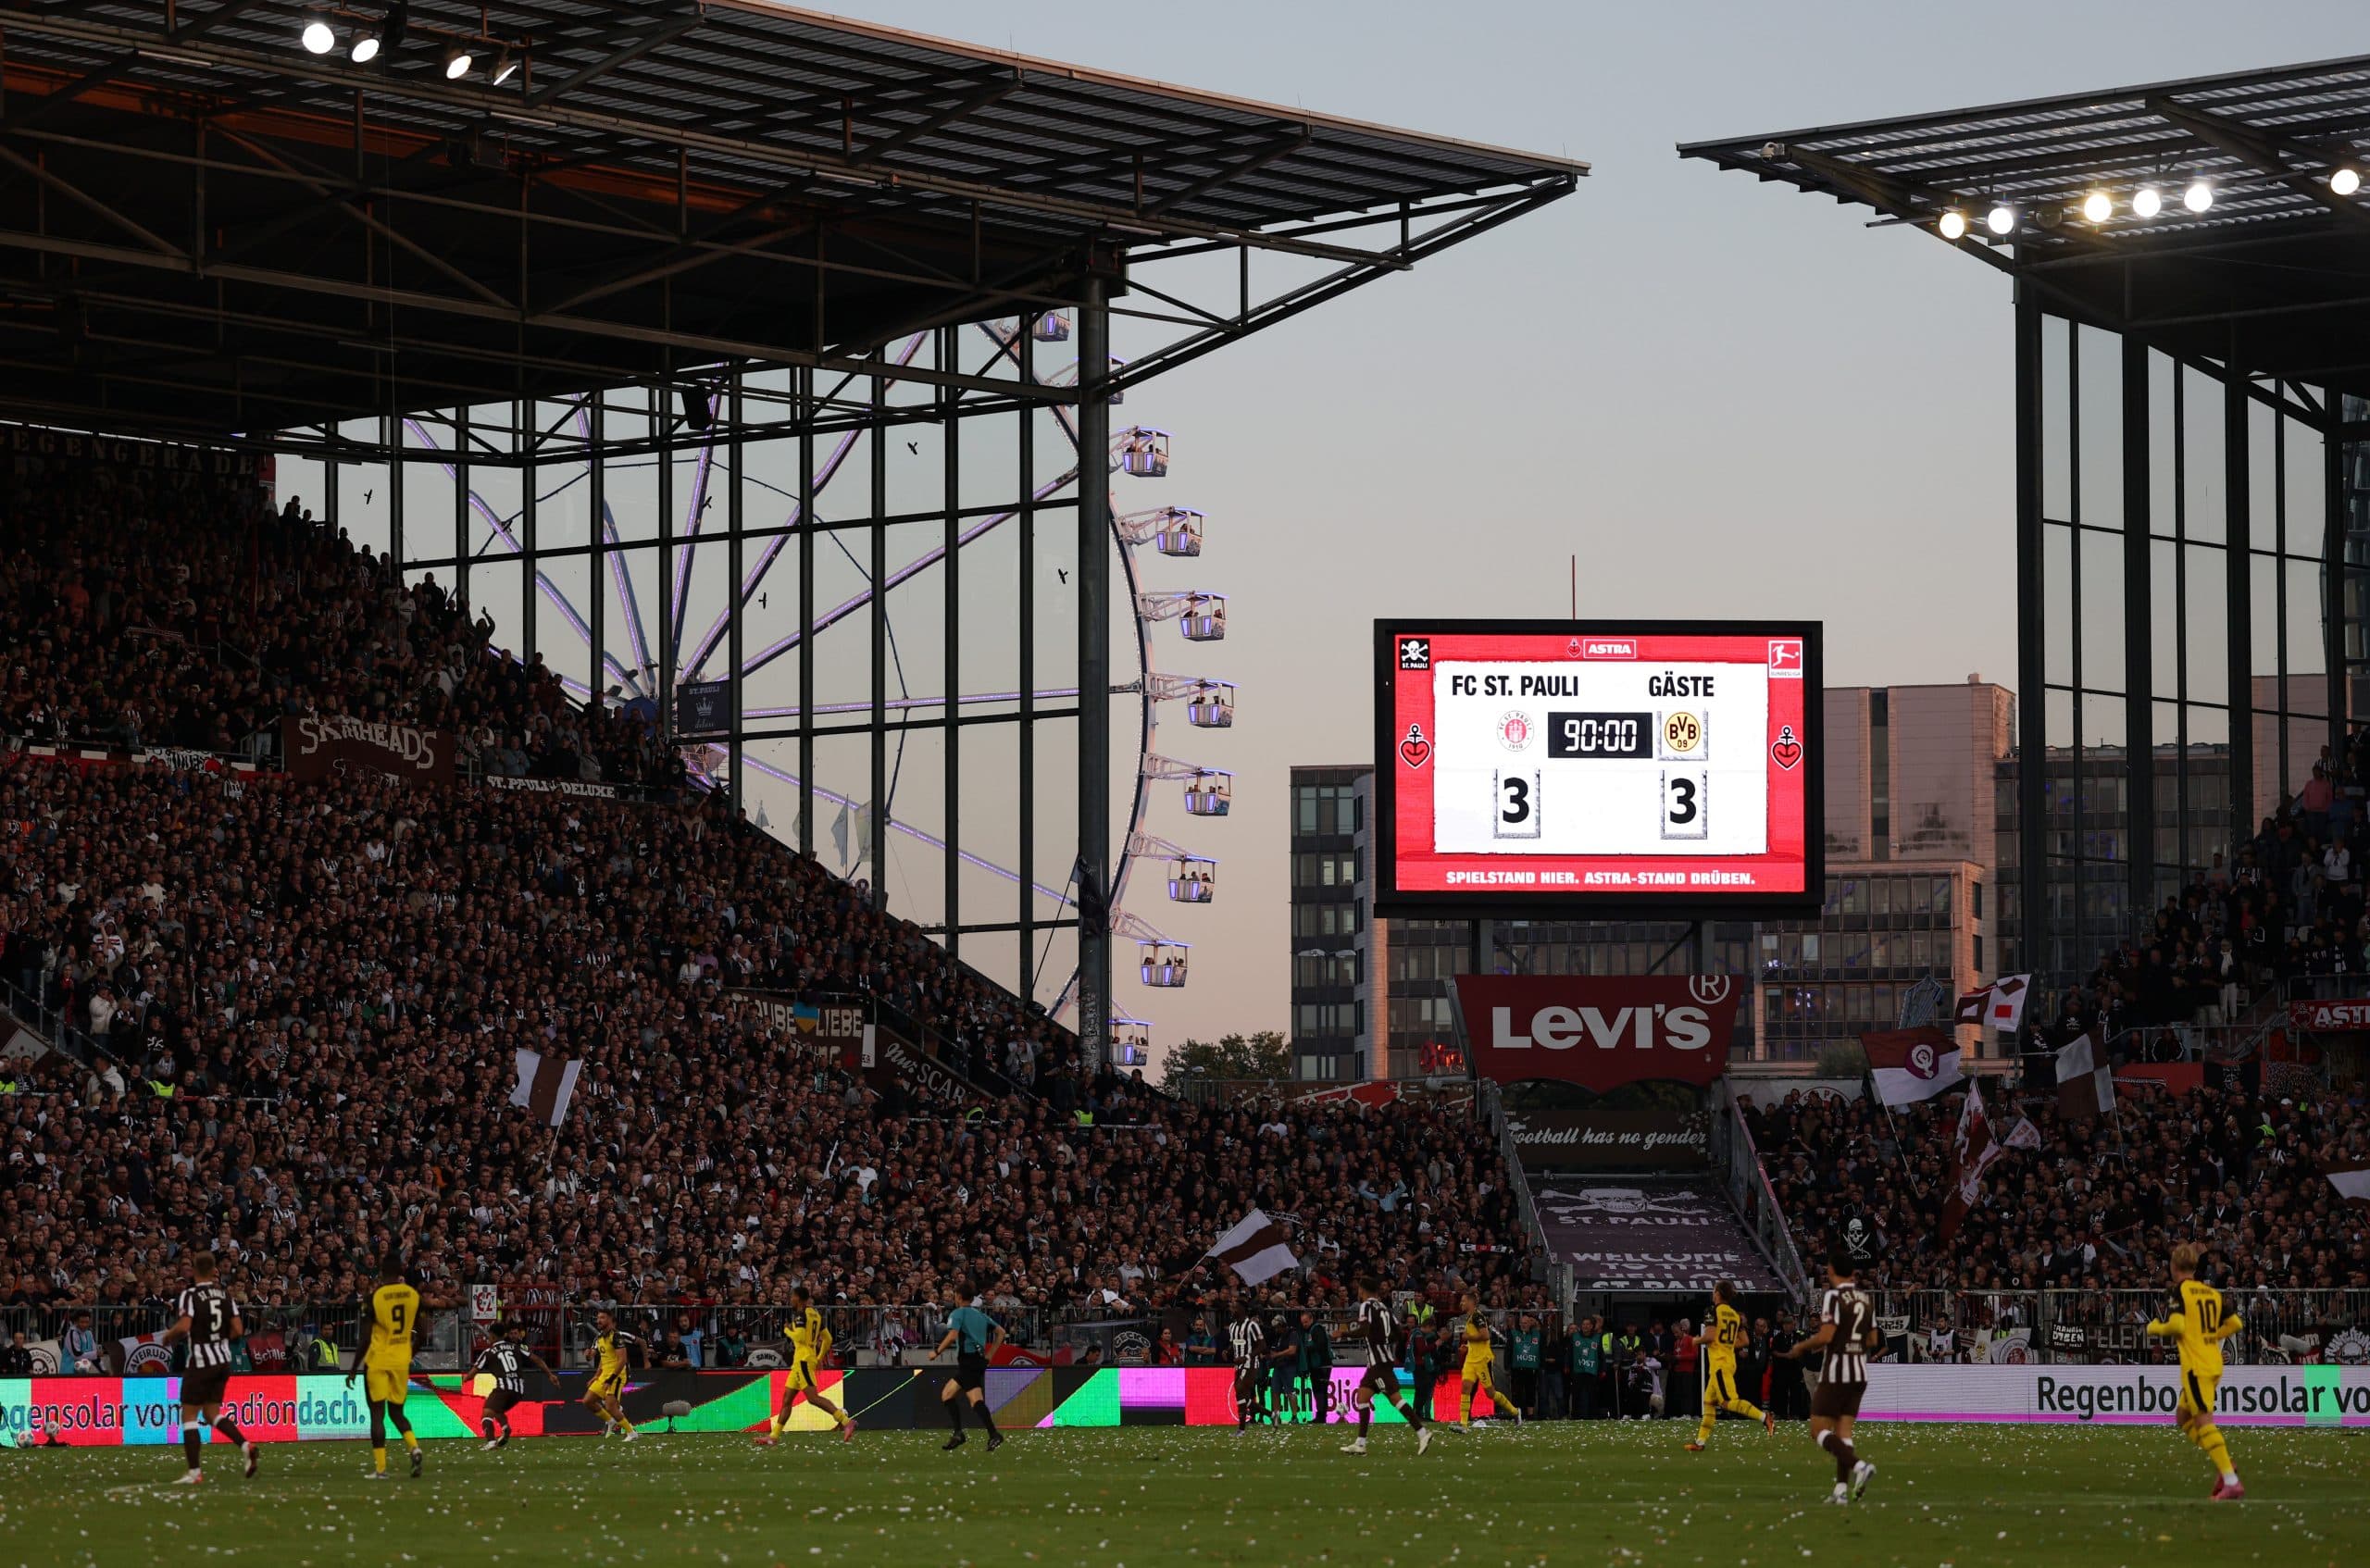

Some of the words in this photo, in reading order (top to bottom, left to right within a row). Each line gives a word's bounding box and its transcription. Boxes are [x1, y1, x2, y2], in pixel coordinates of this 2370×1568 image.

[0, 429, 255, 474] EGENGERADE
[1588, 643, 1631, 654] ASTRA
[1452, 675, 1477, 696] FC
[1484, 675, 1513, 696] ST.
[1520, 675, 1578, 696] PAULI
[1649, 671, 1715, 697] GÄSTE
[1565, 719, 1638, 752] 90:00
[1669, 716, 1697, 740] BVB
[1677, 740, 1688, 749] 09
[560, 782, 616, 799] DELUXE
[1503, 778, 1529, 824] 3
[1669, 778, 1697, 824] 3
[1446, 871, 1536, 884] SPIELSTAND
[1540, 872, 1579, 884] HIER.
[1584, 872, 1686, 884] ASTRA-STAND
[1690, 869, 1755, 885] DRÜBEN.
[815, 1008, 863, 1038] LIEBE
[1582, 1126, 1615, 1145] has
[1620, 1130, 1641, 1145] no
[1644, 1128, 1708, 1151] gender
[1607, 1215, 1710, 1226] PAULI
[209, 1299, 223, 1333] 5
[392, 1304, 405, 1335] 9
[1852, 1301, 1865, 1341] 2
[2197, 1299, 2217, 1334] 10
[1719, 1320, 1737, 1344] 20
[497, 1350, 518, 1373] 16
[1326, 1378, 1376, 1412] Blic
[2037, 1375, 2326, 1421] Regenbonsolar
[2332, 1386, 2370, 1413] vo
